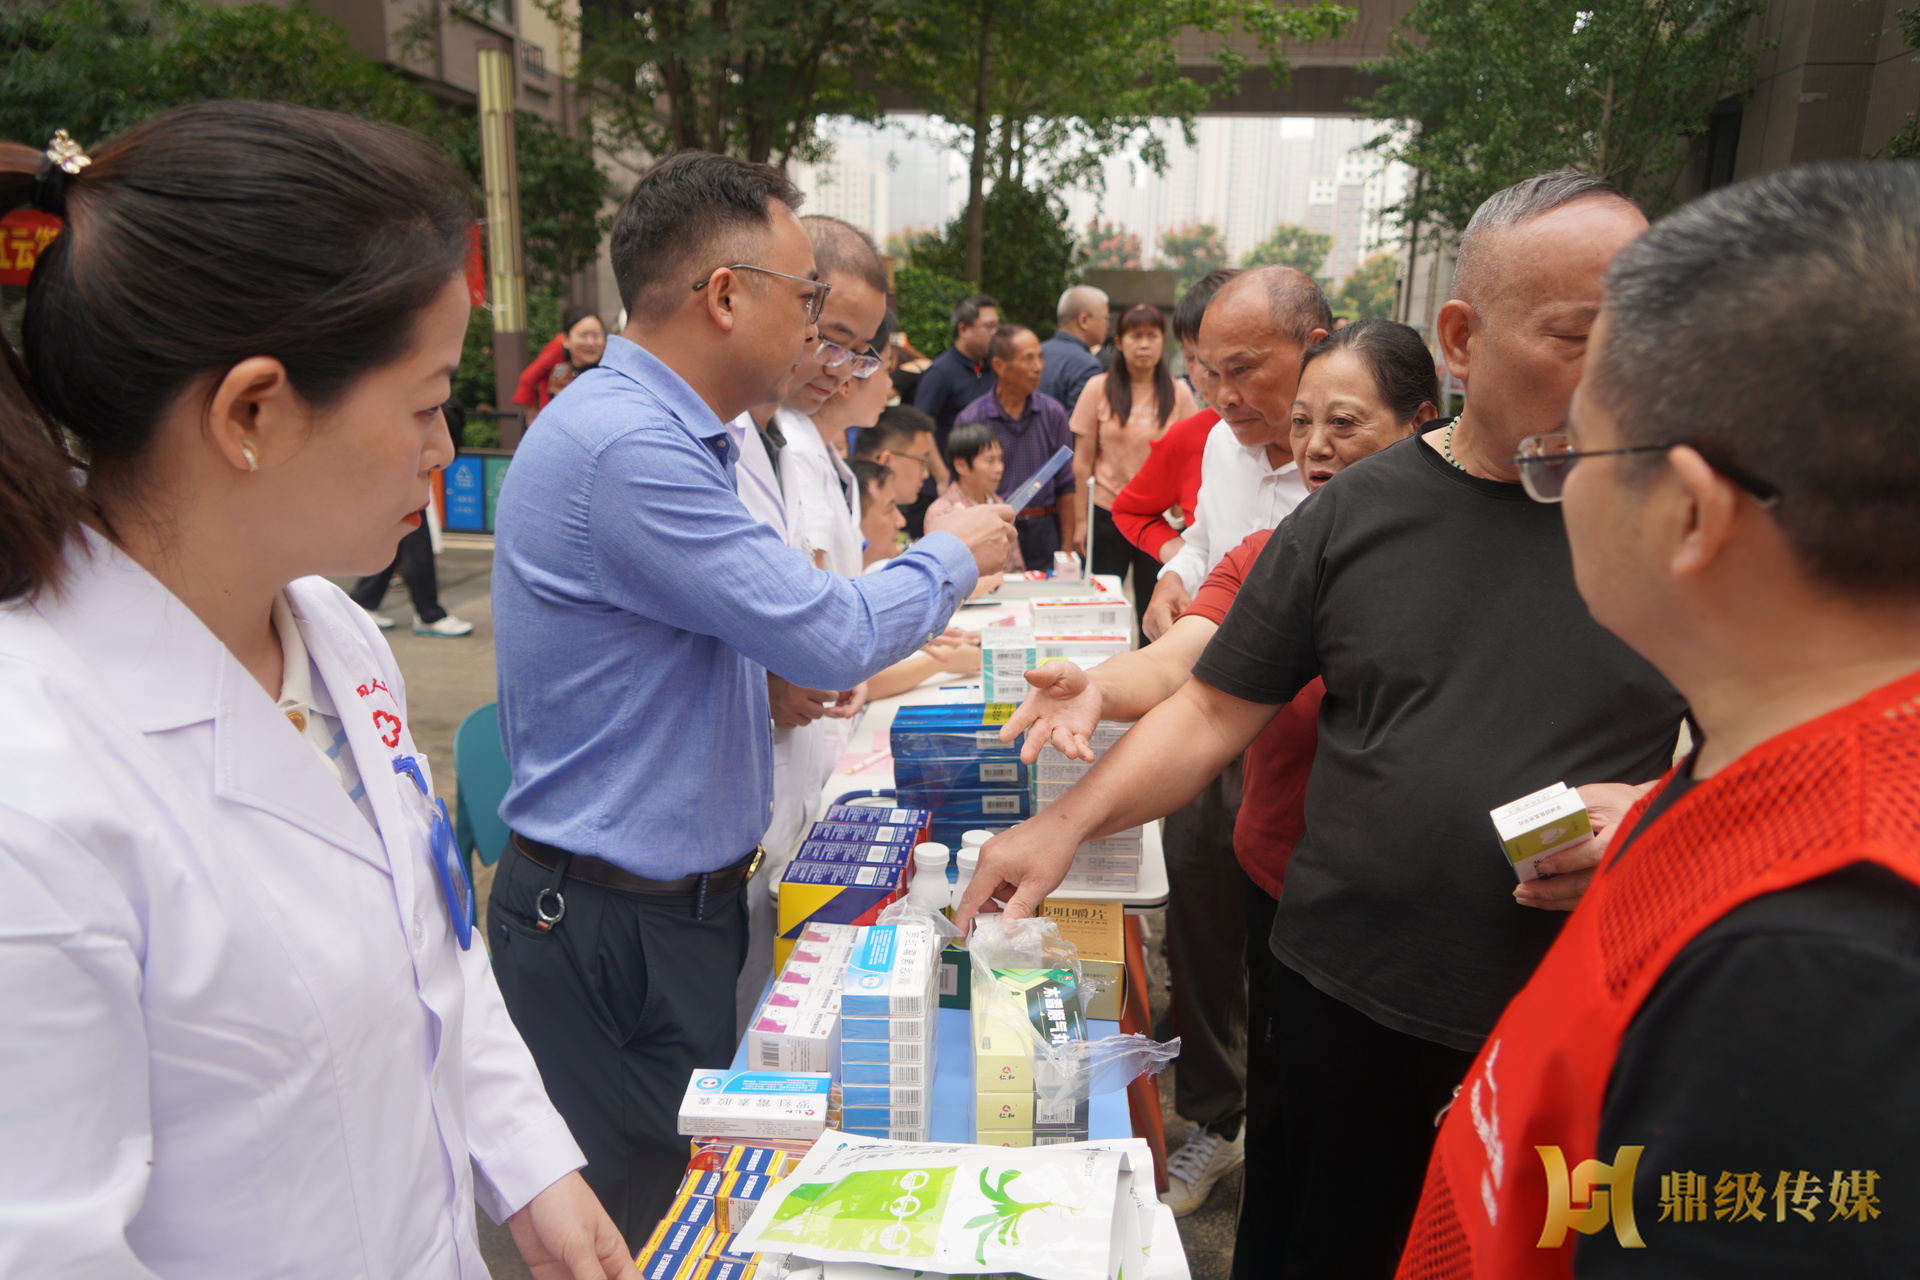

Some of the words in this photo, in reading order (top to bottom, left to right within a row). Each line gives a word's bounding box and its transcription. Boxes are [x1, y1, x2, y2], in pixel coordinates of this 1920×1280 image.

[1043, 986, 1070, 1045] 木香顺气丸
